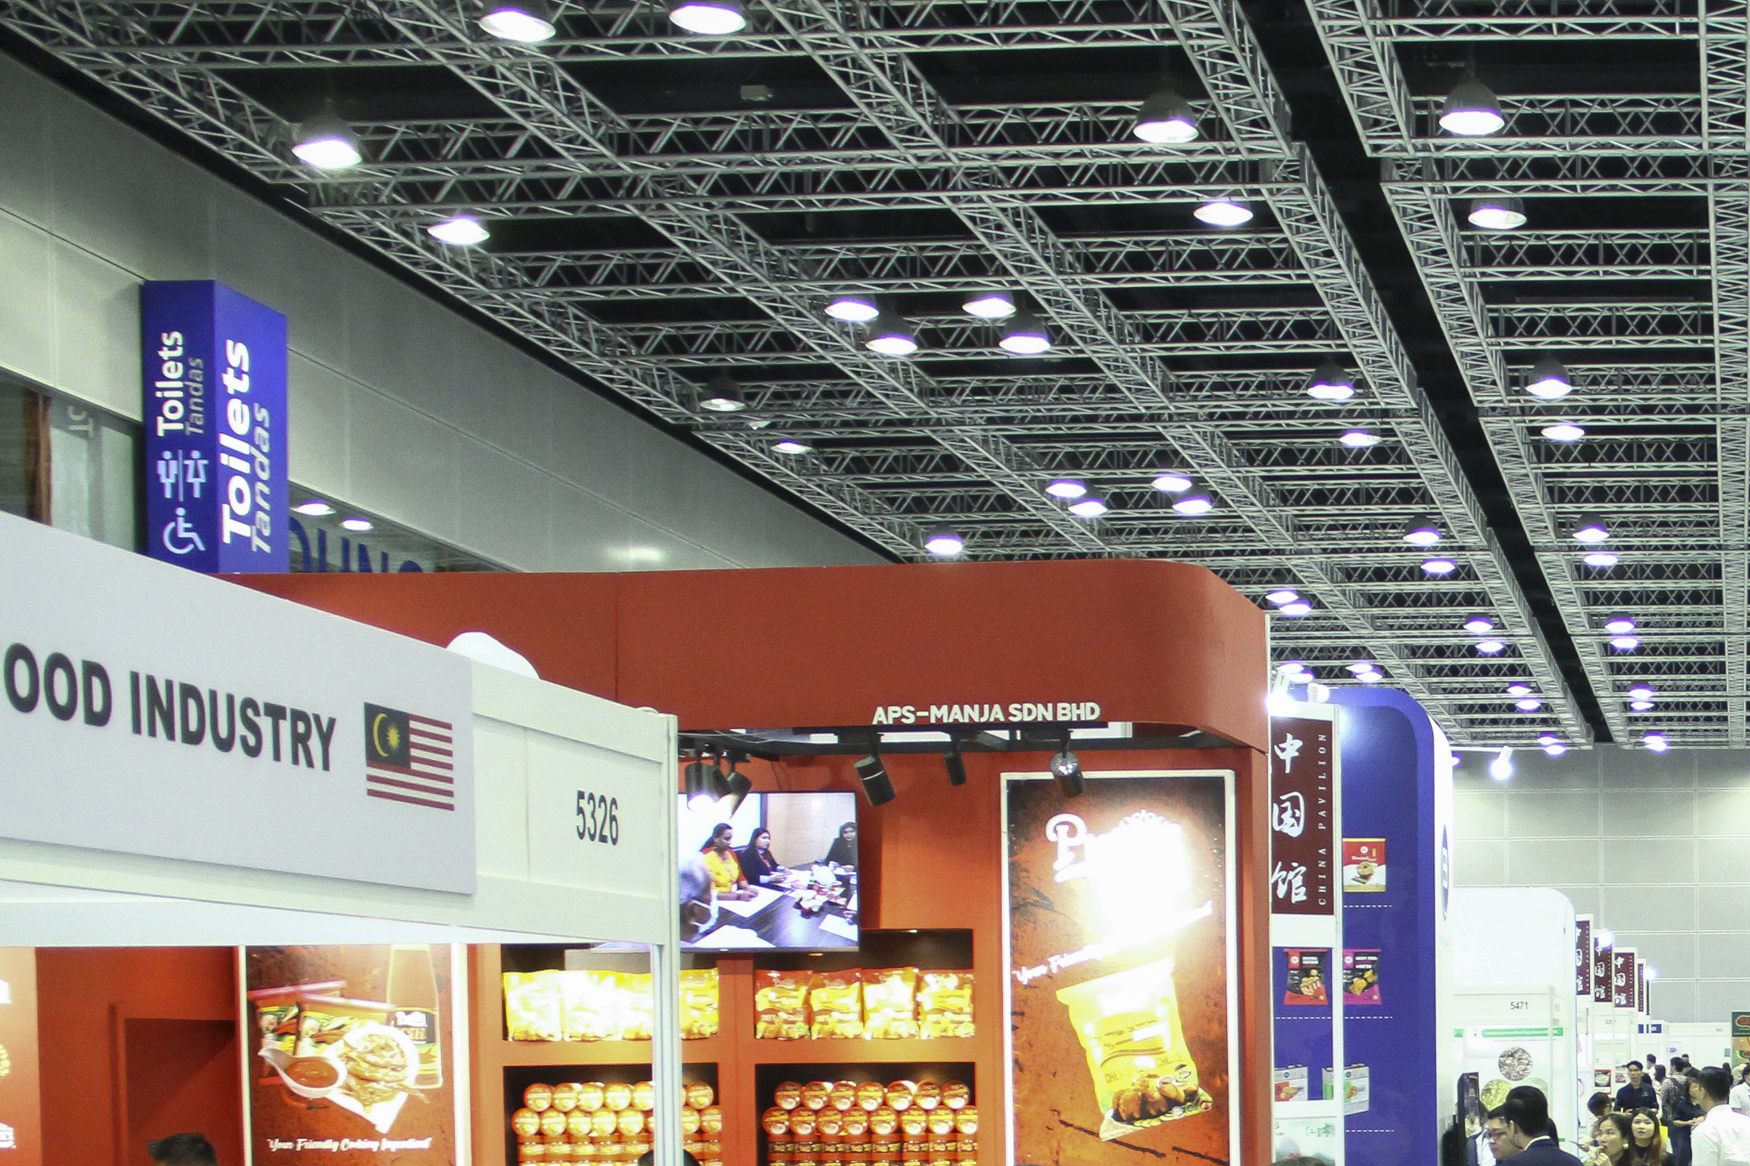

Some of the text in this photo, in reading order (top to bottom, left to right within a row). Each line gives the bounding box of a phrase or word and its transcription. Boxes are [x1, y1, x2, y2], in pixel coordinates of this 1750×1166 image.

[156, 331, 184, 437] Toilets
[185, 357, 204, 435] Tandas
[219, 339, 251, 544] Toilets
[250, 402, 271, 554] Tandas
[130, 669, 336, 771] INDUSTRY
[872, 701, 1101, 725] APS-MANJA SDN BHD
[576, 789, 620, 846] 5326
[1318, 733, 1327, 906] CHINA PAVILION
[1510, 1002, 1528, 1010] 5471
